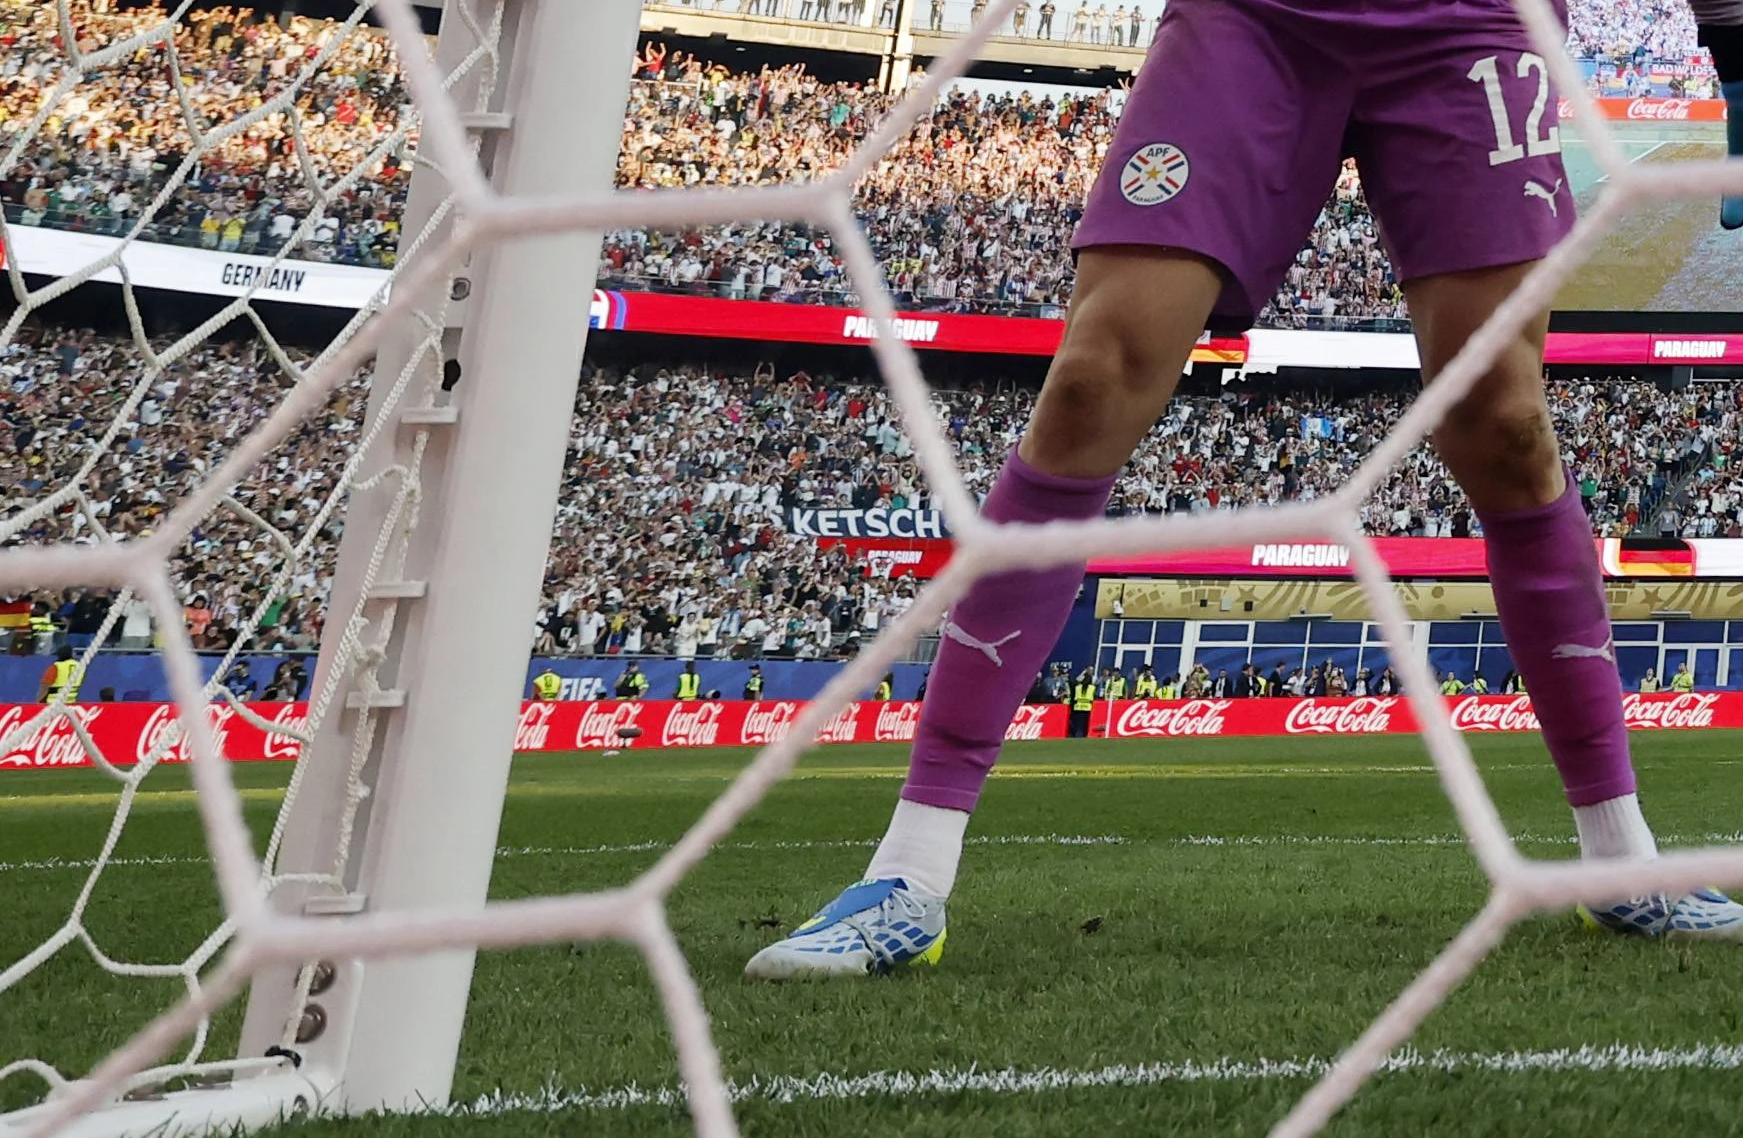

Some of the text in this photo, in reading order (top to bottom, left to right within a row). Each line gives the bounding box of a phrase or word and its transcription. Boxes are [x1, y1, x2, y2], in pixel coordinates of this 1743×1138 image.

[1467, 53, 1560, 167] 12
[1146, 147, 1170, 158] APF
[1654, 340, 1726, 358] PARAGUAY
[793, 507, 943, 538] KETSCH
[1251, 544, 1350, 567] PARAGUAY
[1117, 700, 1232, 736] Coca-Cola
[1285, 697, 1399, 733] Coca-Cola
